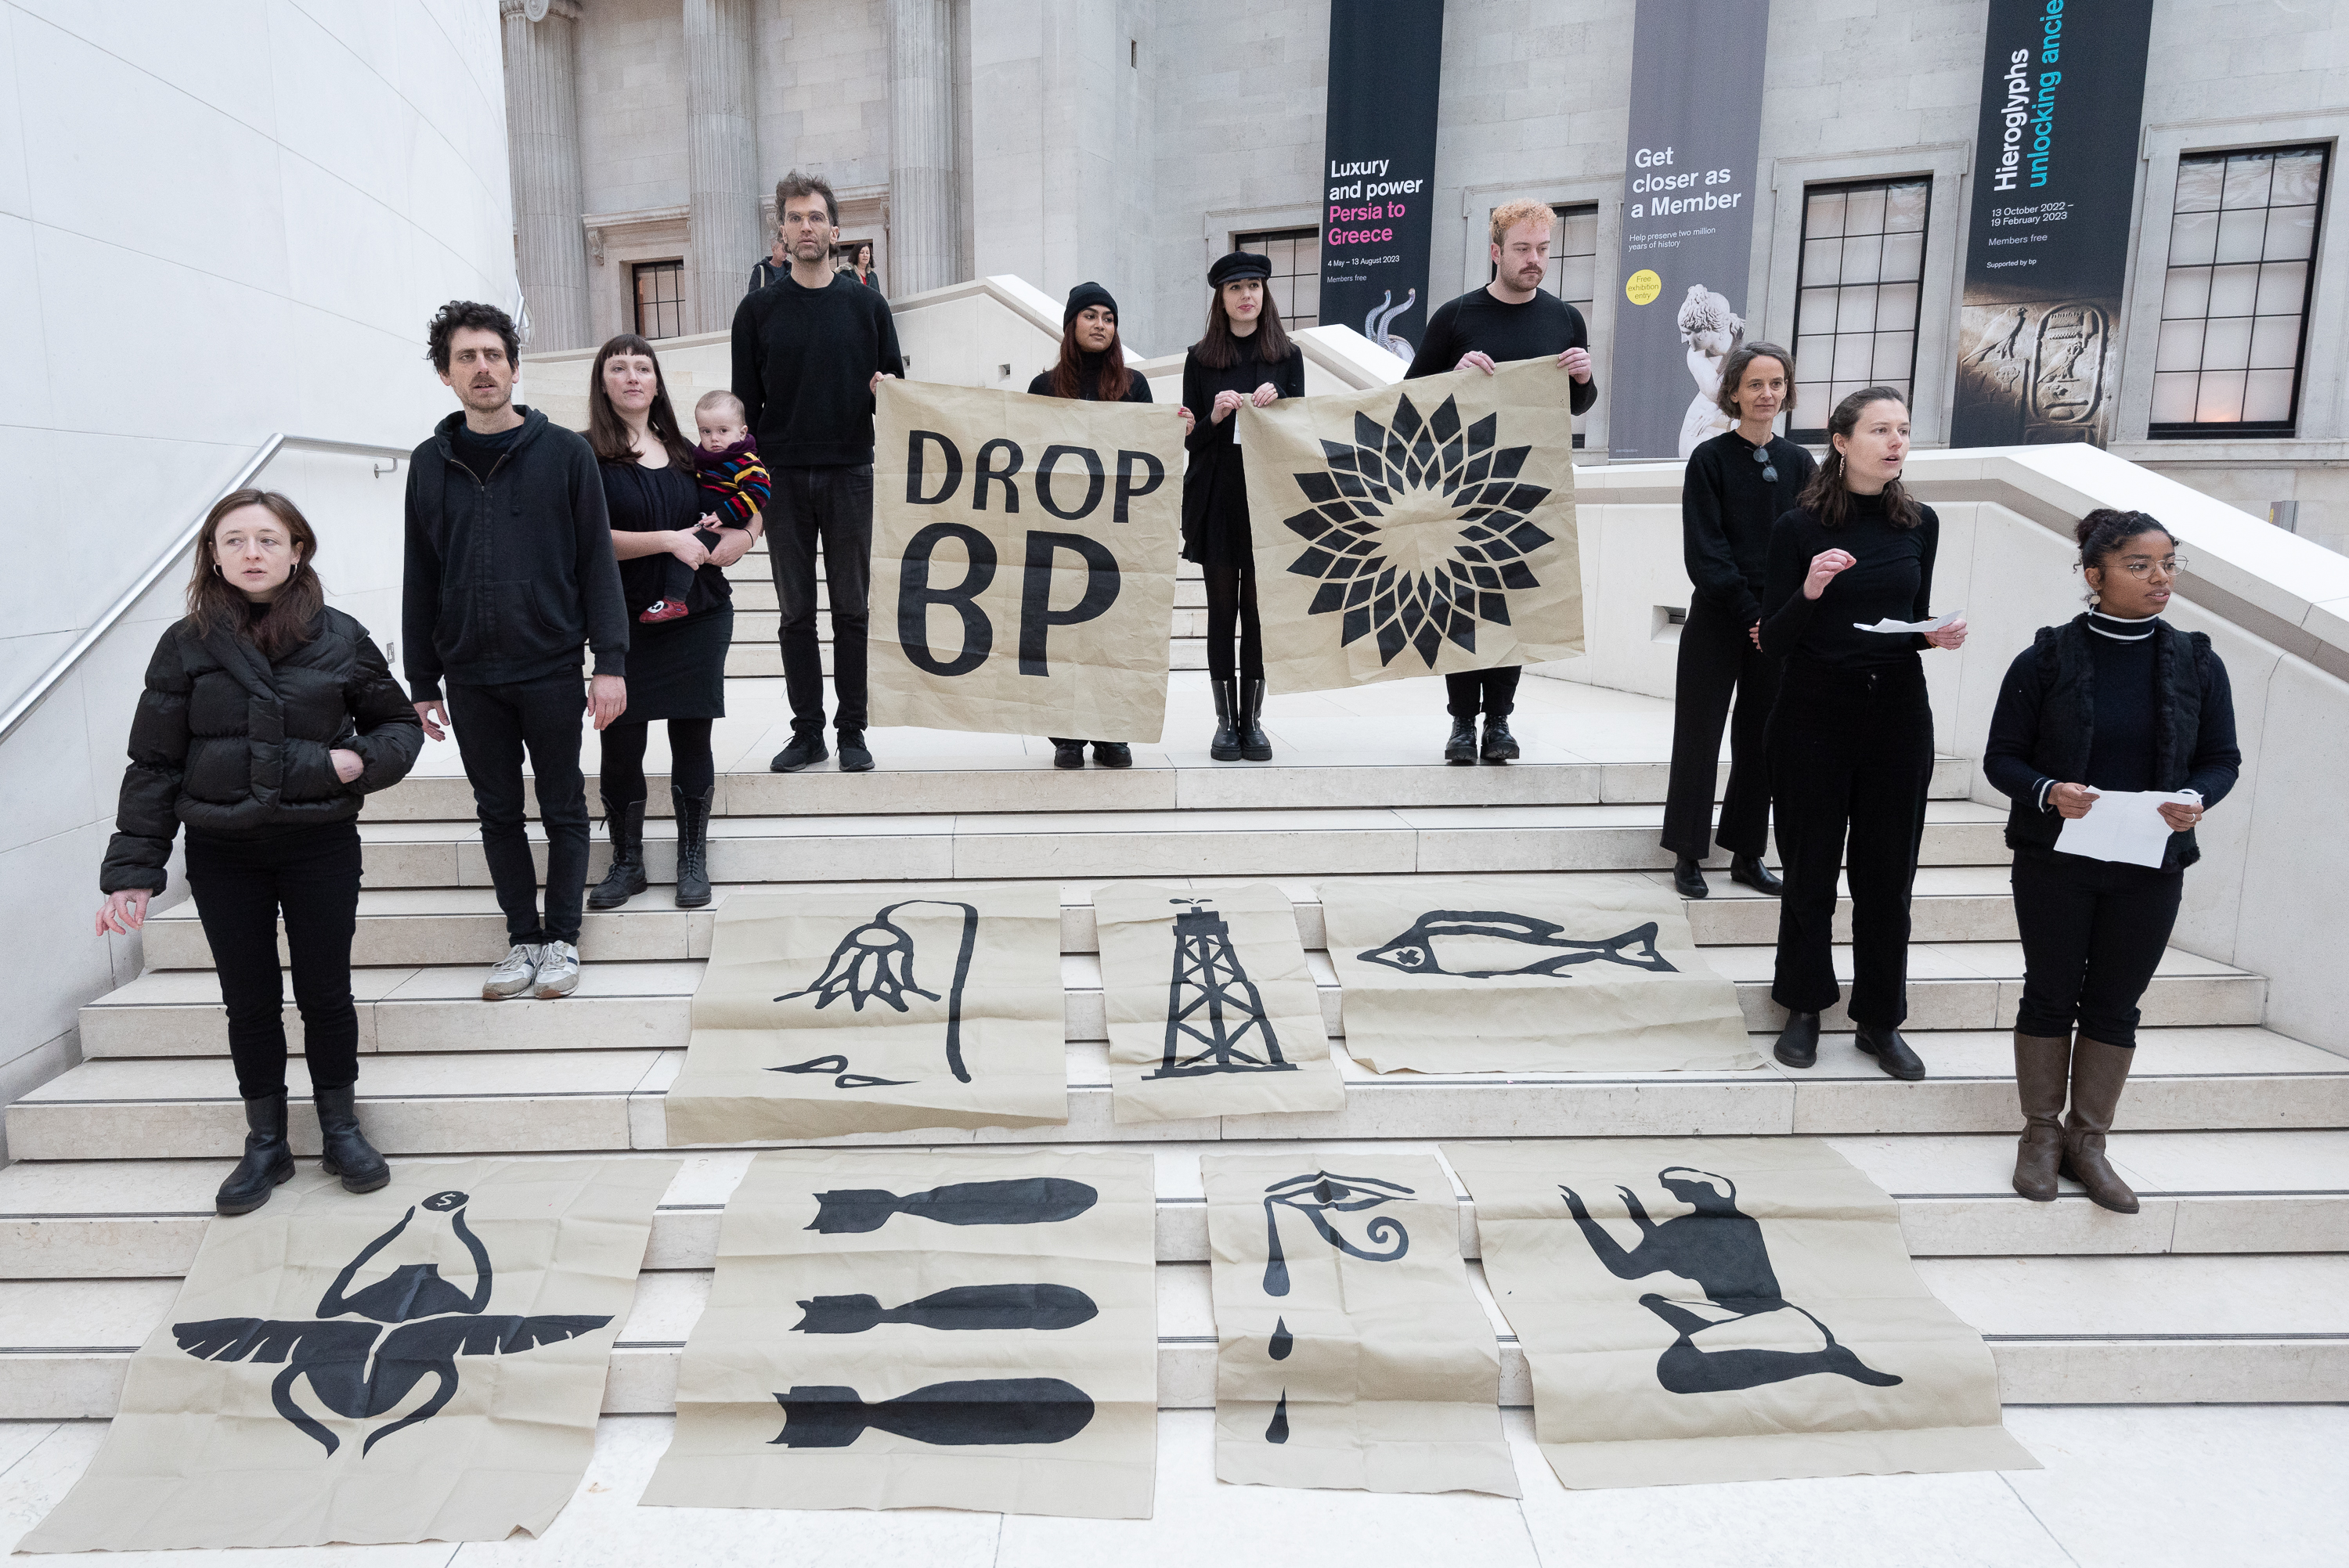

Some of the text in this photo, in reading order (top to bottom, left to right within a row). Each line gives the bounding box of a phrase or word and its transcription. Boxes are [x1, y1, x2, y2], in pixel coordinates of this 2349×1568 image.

[2026, 0, 2064, 188] unlocking ancie
[1994, 48, 2030, 191] Hieroglyphs
[1634, 146, 1674, 168] Get
[1331, 159, 1389, 178] Luxury
[1329, 178, 1423, 200] and power
[1633, 168, 1731, 193] closer as
[1330, 201, 1405, 223] Persia to
[1630, 192, 1742, 218] a Member
[1991, 208, 2001, 218] 13
[2004, 204, 2038, 217] October
[2040, 202, 2066, 212] 2022
[1990, 211, 2067, 227] 19 February 2023
[1328, 228, 1393, 246] Greece
[1629, 232, 1646, 242] Help
[1647, 231, 1677, 241] preserve
[1693, 227, 1716, 236] million
[1988, 233, 2048, 247] Members free
[1628, 243, 1647, 252] years
[1658, 240, 1681, 249] history
[1333, 259, 1344, 268] May
[1360, 257, 1382, 266] August
[1383, 255, 1400, 264] 2023
[1986, 259, 2019, 269] Supported
[2028, 257, 2037, 265] bp
[1628, 283, 1659, 292] exhibition
[1634, 292, 1651, 301] entry
[906, 430, 1164, 523] DROP
[897, 522, 1120, 677] BP
